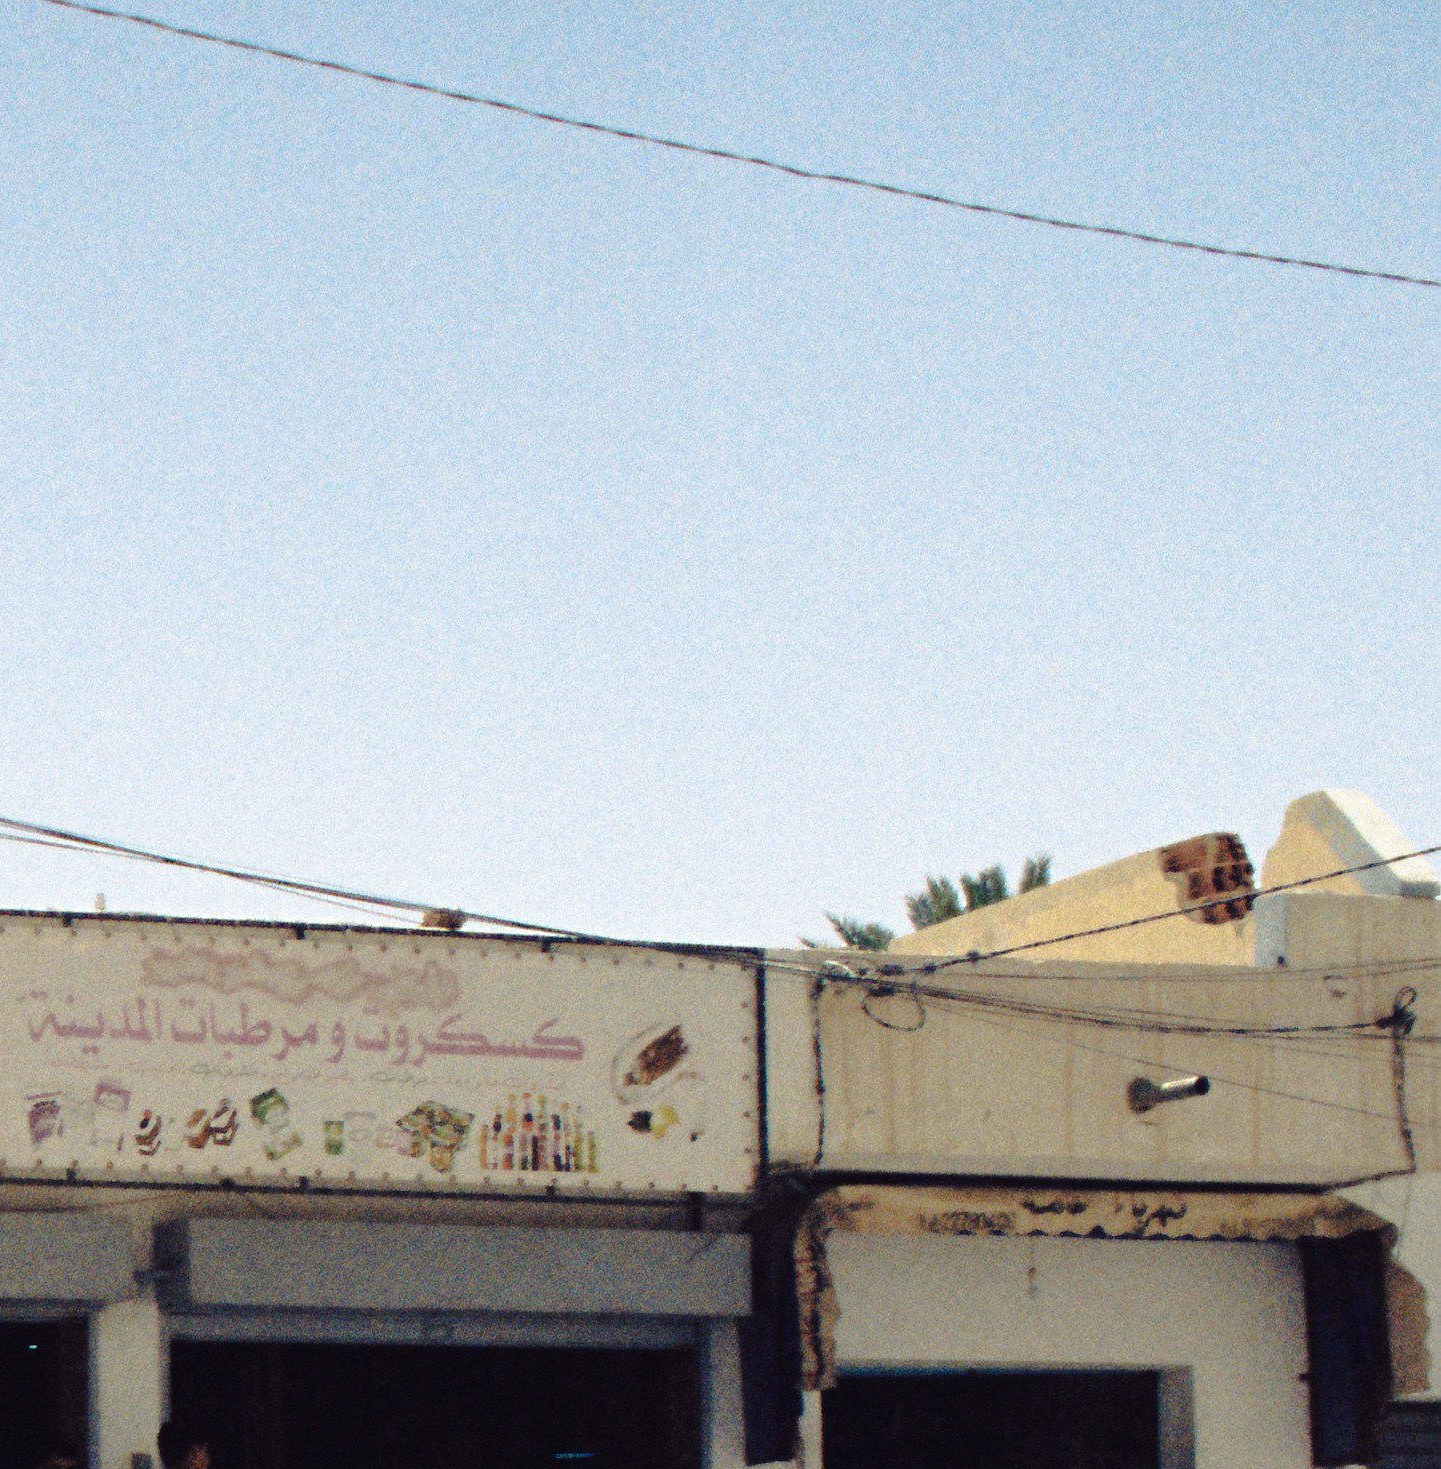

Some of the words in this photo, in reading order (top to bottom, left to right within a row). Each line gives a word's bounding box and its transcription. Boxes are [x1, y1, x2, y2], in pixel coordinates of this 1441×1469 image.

[27, 989, 162, 1055] المدينة
[170, 995, 318, 1062] مرطبات
[353, 1007, 586, 1067] كسكروت
